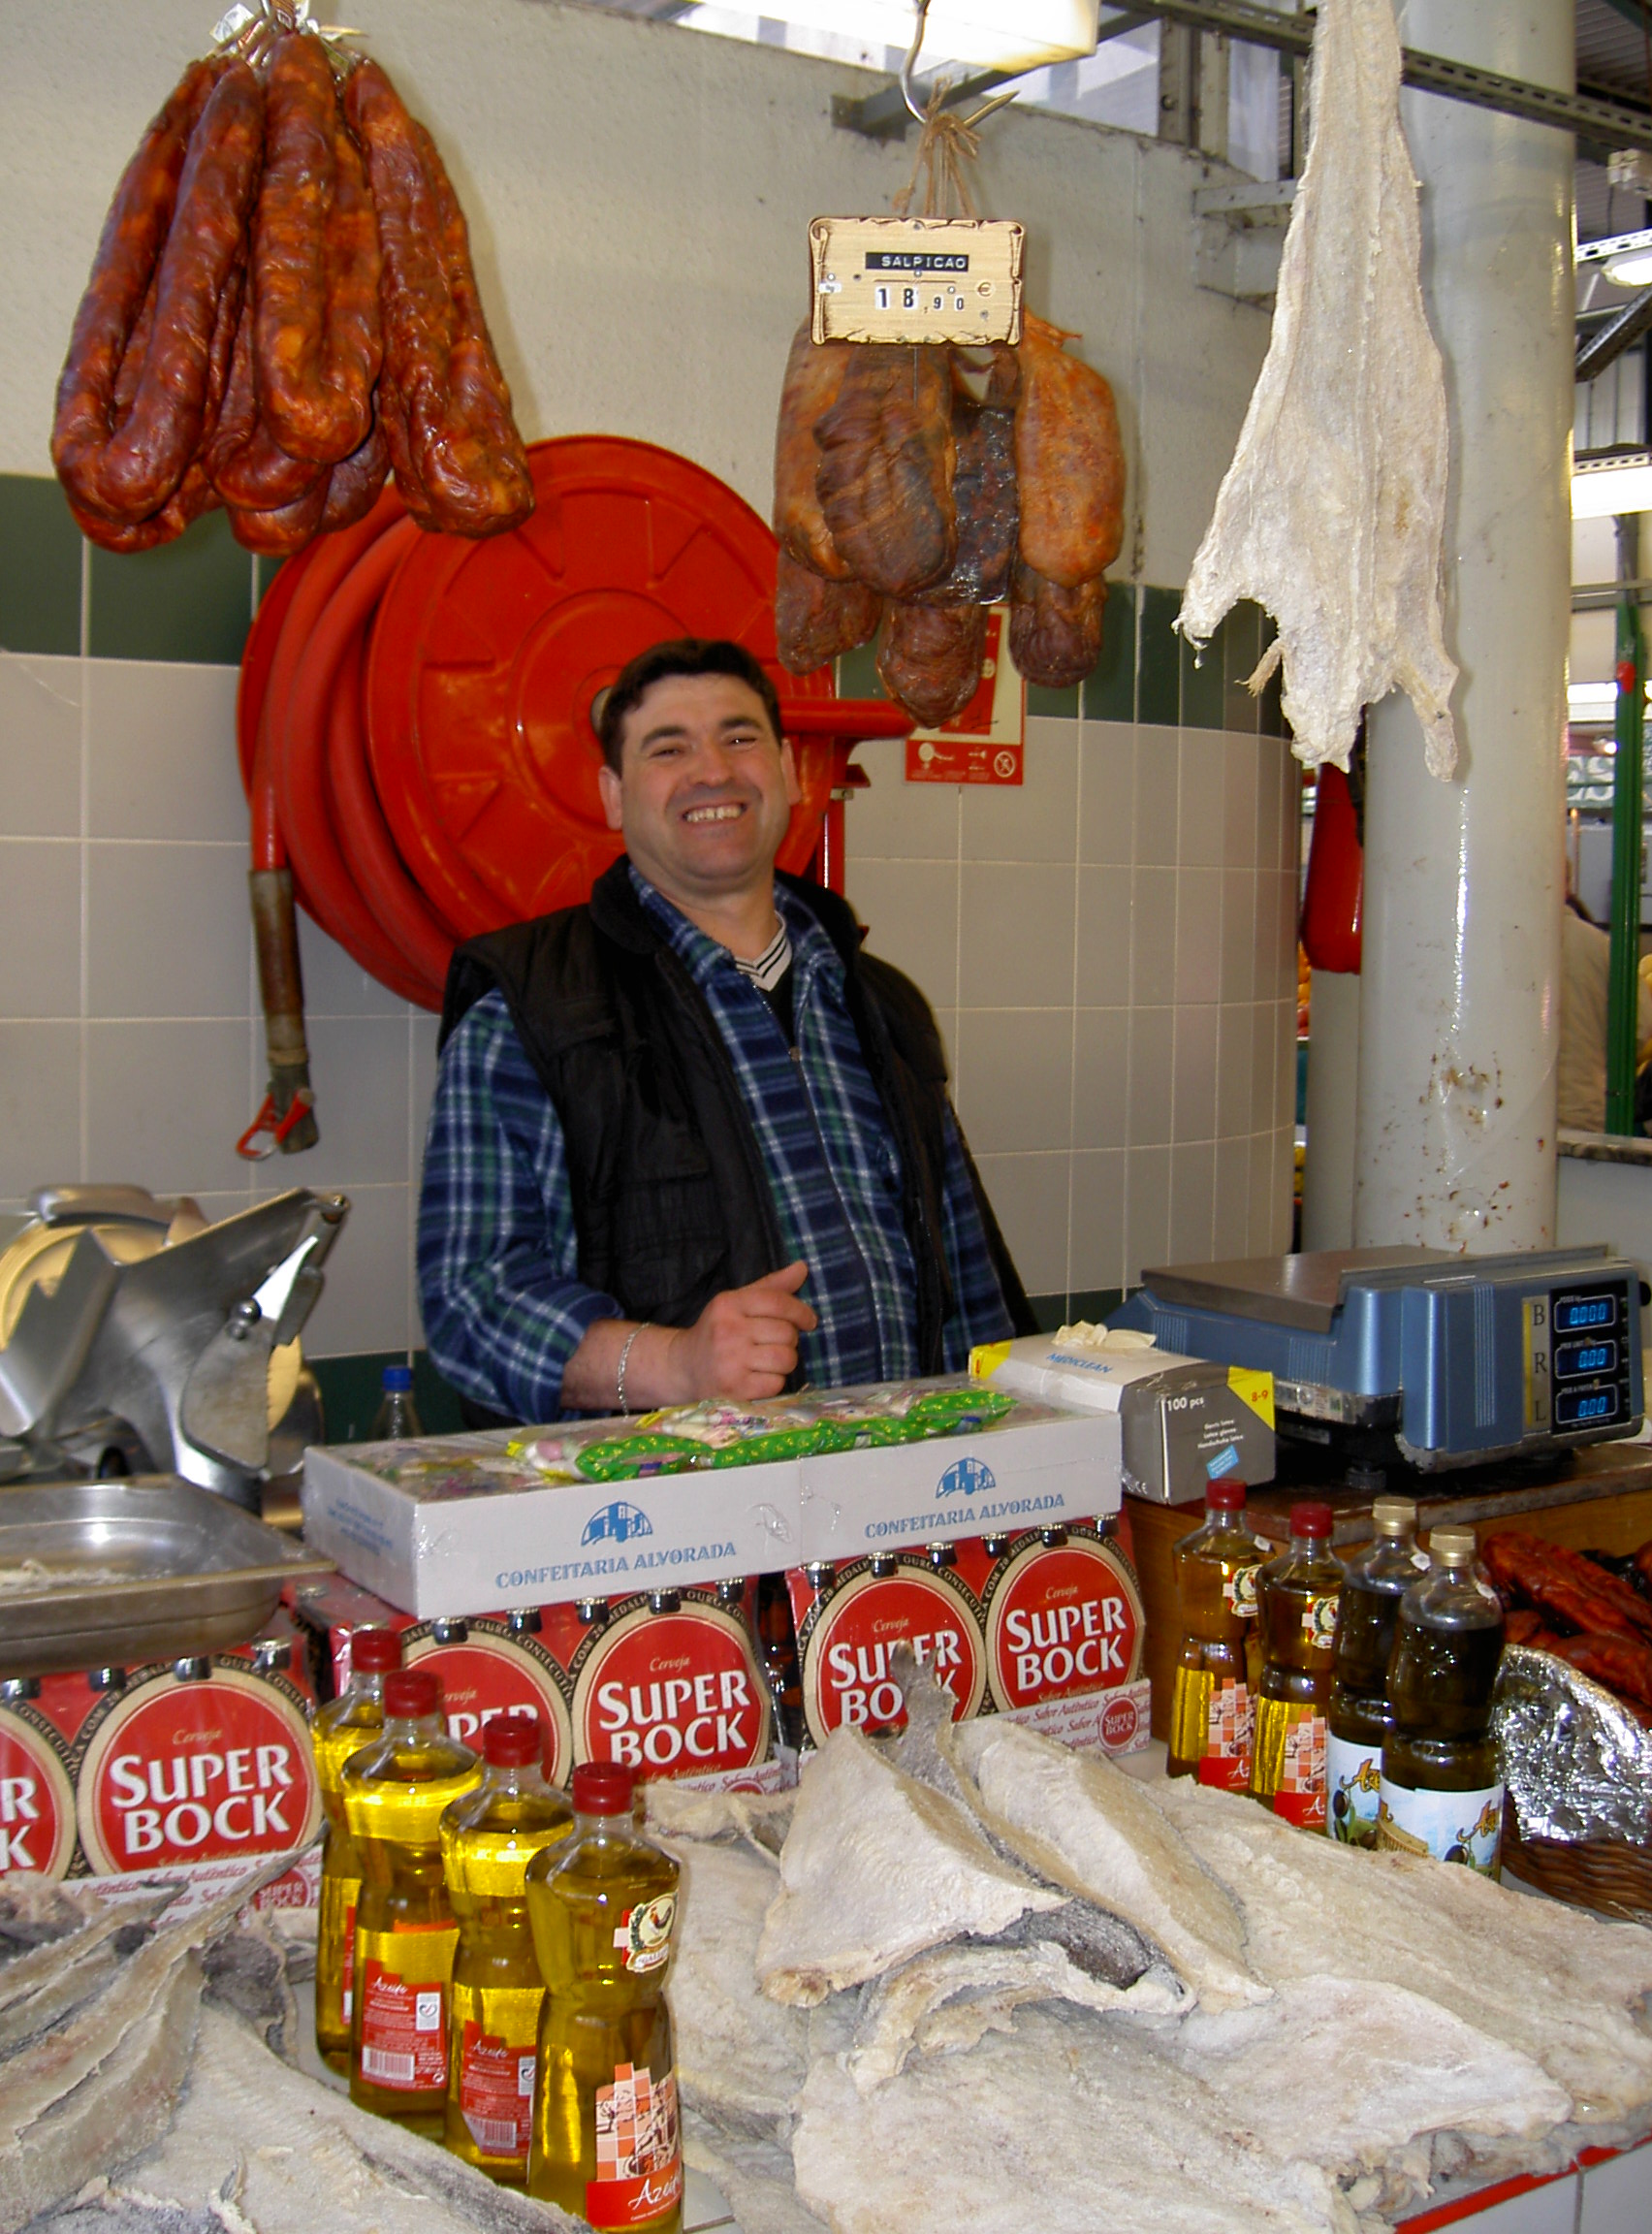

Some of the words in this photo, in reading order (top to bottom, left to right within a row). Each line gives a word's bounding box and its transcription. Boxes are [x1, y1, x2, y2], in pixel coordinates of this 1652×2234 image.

[880, 256, 967, 270] SALPICAO
[977, 281, 993, 297] €
[1533, 1304, 1545, 1326] B
[1046, 1352, 1114, 1374] MEDICLEAN
[1534, 1352, 1547, 1374] R
[1166, 1396, 1188, 1413] 100
[1189, 1395, 1205, 1411] pcs
[1251, 1389, 1269, 1403] 8-9
[1535, 1400, 1546, 1422] L
[865, 1507, 976, 1539] CONFEITARIA
[979, 1492, 1065, 1521] ALVORADA
[495, 1553, 628, 1589] CONFEITARIA
[634, 1541, 737, 1572] ALVORADA
[1045, 1583, 1079, 1602] Cerveja
[873, 1616, 910, 1634] Cerveja
[1005, 1595, 1128, 1654] SUPER
[649, 1654, 691, 1673] Cerveja
[1016, 1634, 1126, 1691] BOCK
[443, 1687, 478, 1705] erveja
[597, 1669, 751, 1731] SUPER
[840, 1667, 957, 1727] BOK
[1033, 1707, 1059, 1723] Sabor
[1104, 1711, 1134, 1727] SUPER
[610, 1711, 748, 1769] BOCK
[1105, 1723, 1133, 1738] BOCK
[109, 1744, 294, 1809] SUPER
[124, 1791, 290, 1855] BOCK
